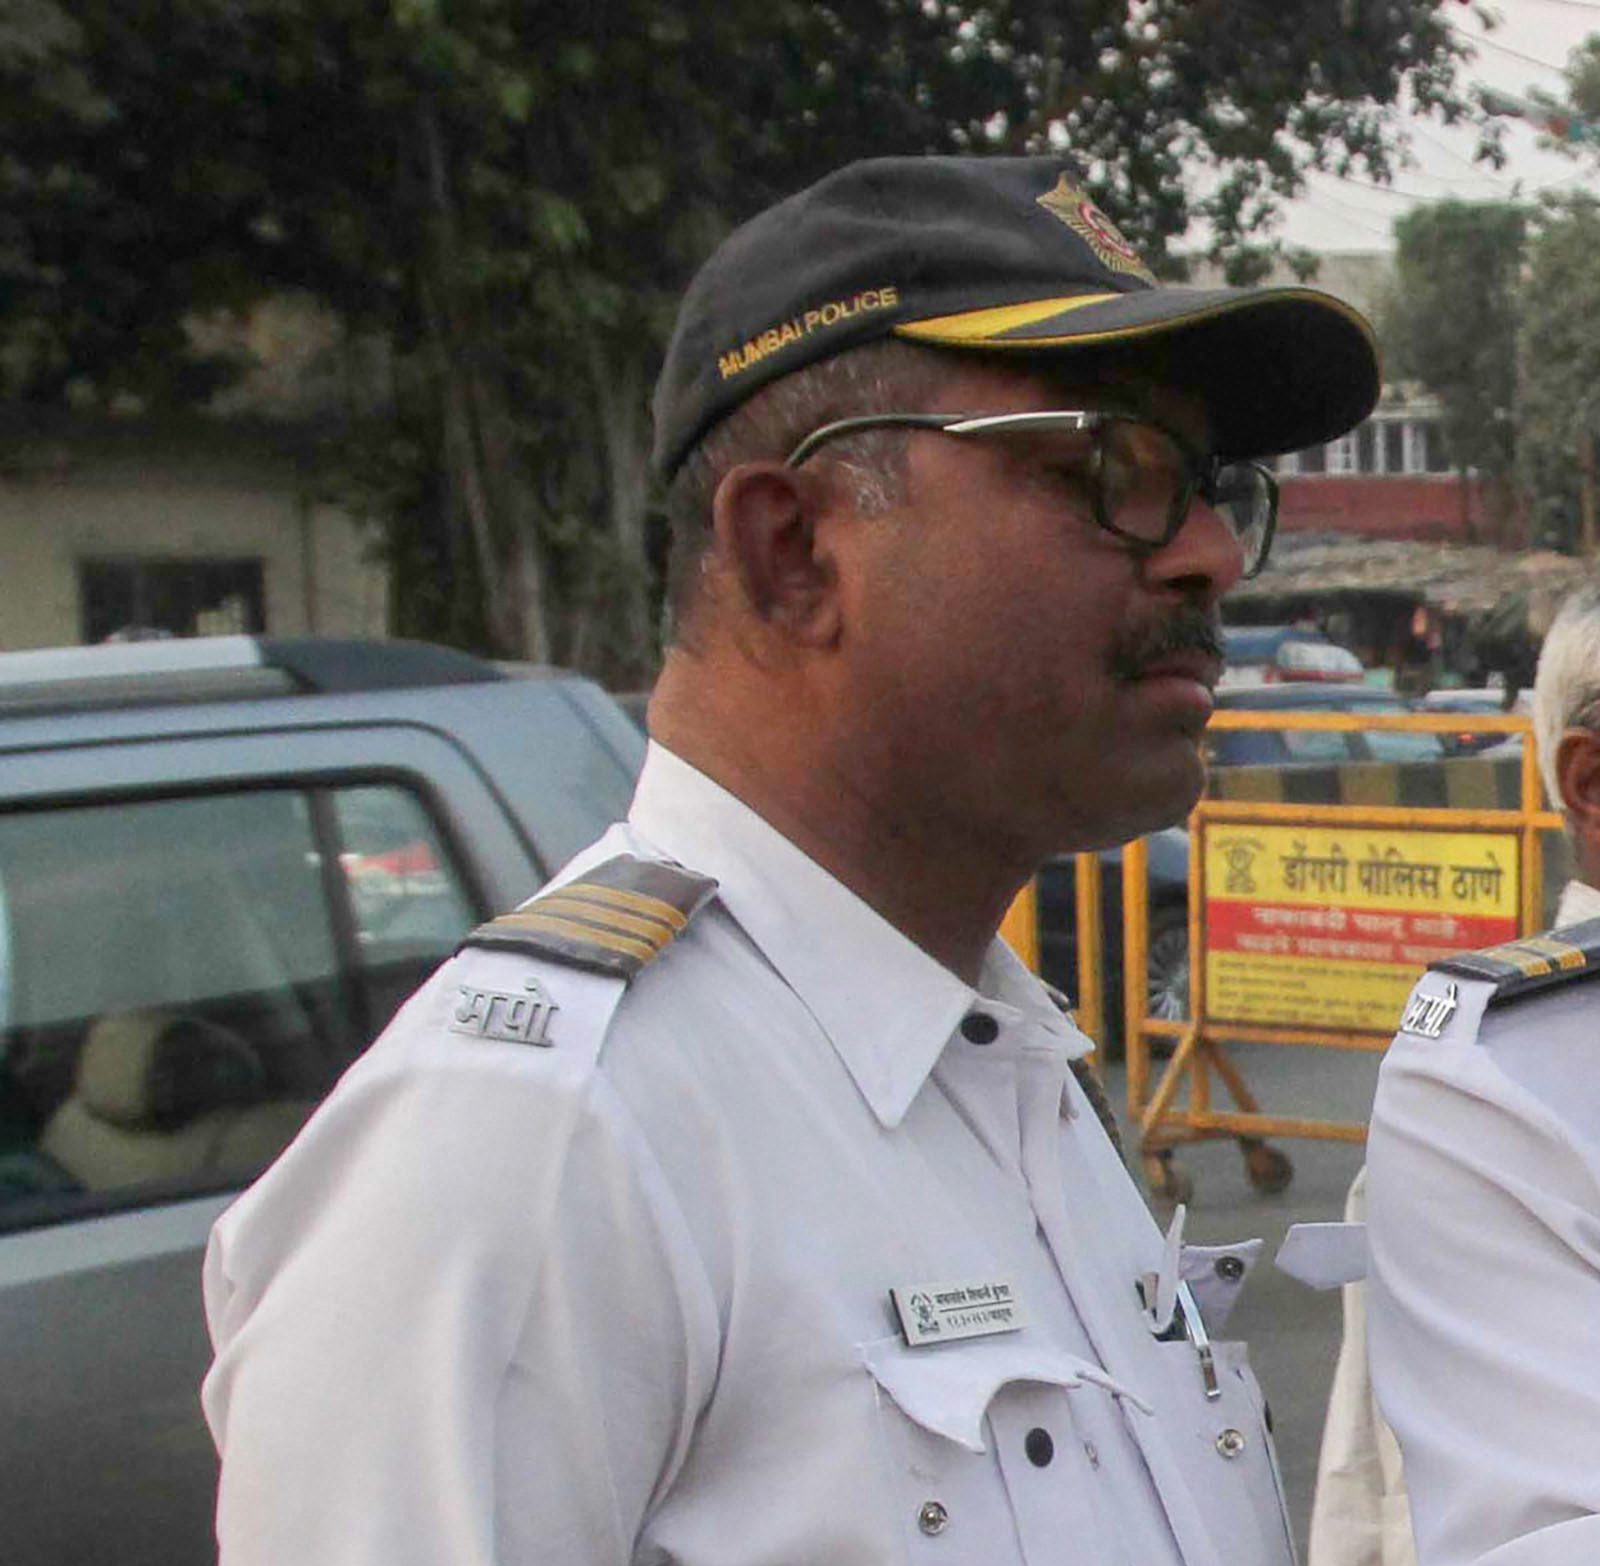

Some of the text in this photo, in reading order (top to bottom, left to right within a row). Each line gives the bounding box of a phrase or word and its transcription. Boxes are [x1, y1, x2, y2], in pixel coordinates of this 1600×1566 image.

[718, 286, 898, 380] MUMBAI POLICE
[1356, 842, 1442, 900] पोलिस
[1449, 850, 1504, 904] ठाणे
